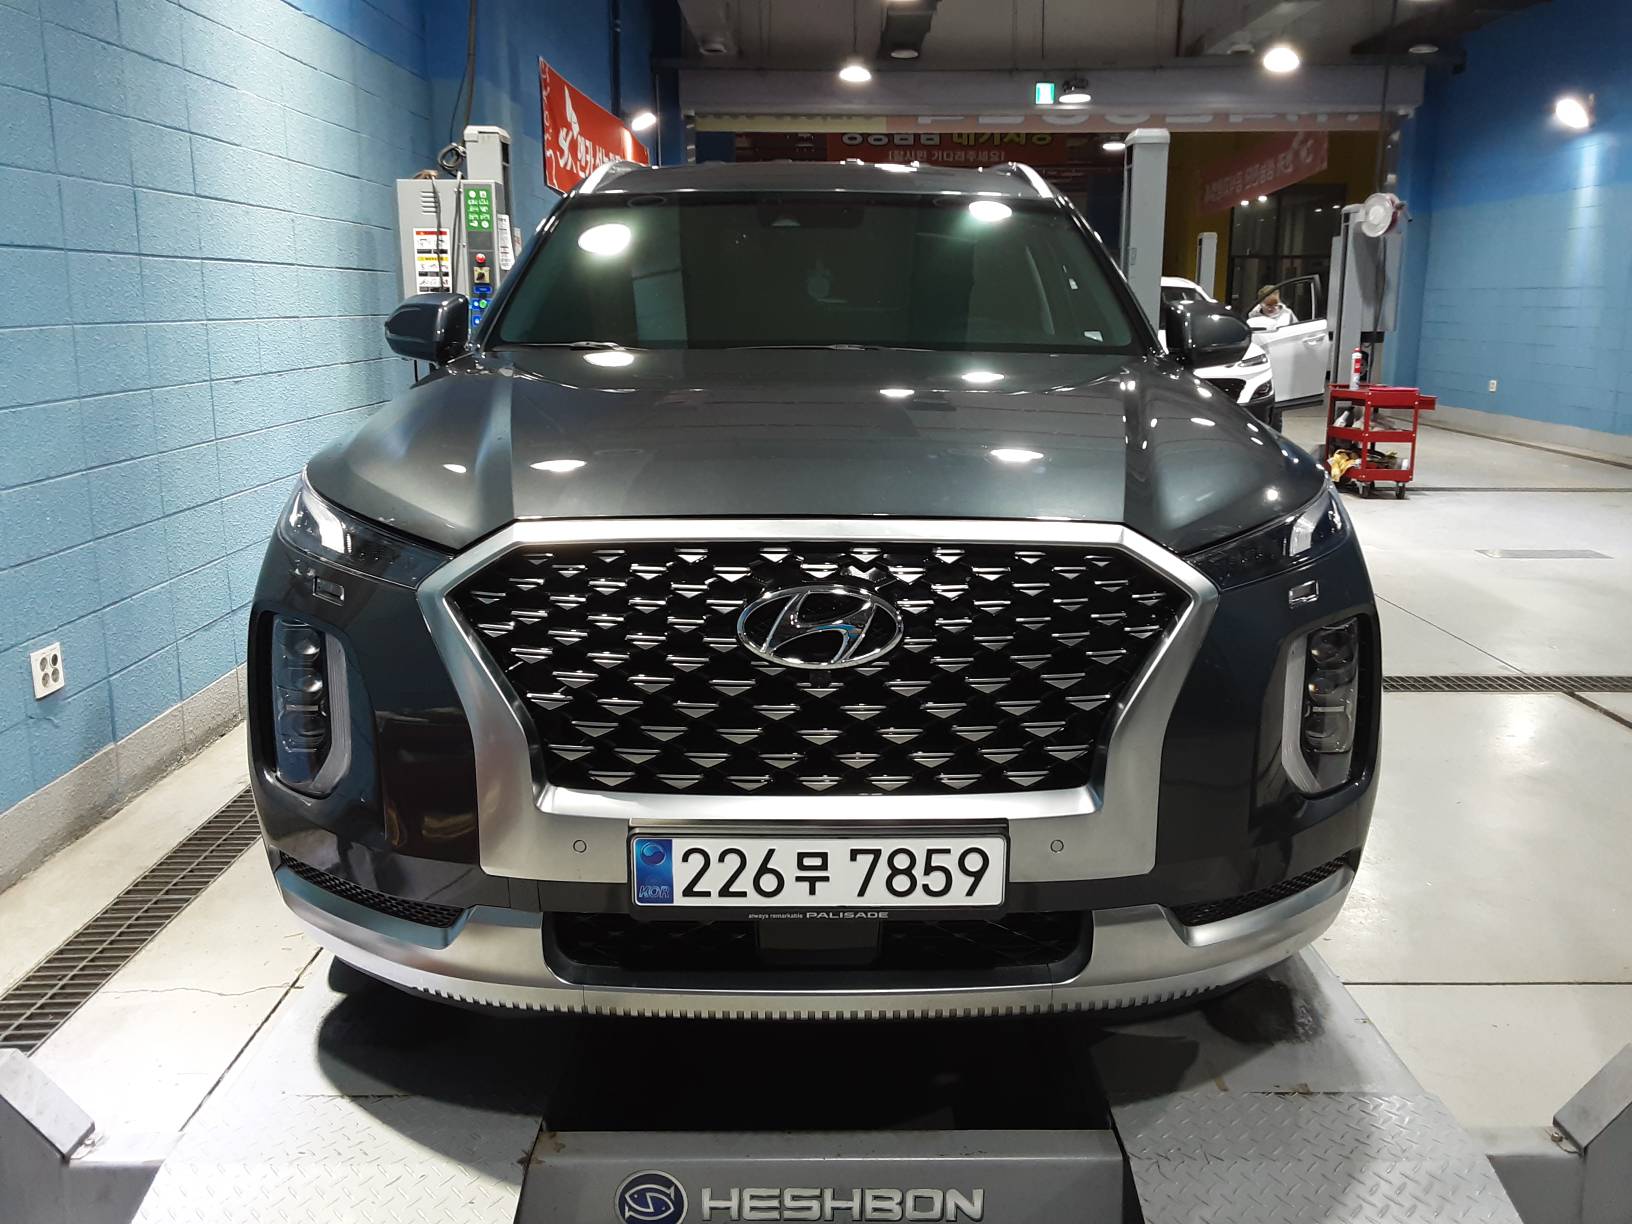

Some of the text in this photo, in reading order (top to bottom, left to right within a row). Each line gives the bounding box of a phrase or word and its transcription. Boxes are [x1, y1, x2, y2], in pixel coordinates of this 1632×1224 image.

[681, 847, 991, 898] 226무 7859
[638, 883, 671, 900] KOR
[806, 911, 889, 919] PALISADE
[701, 1187, 985, 1223] HESHBON
